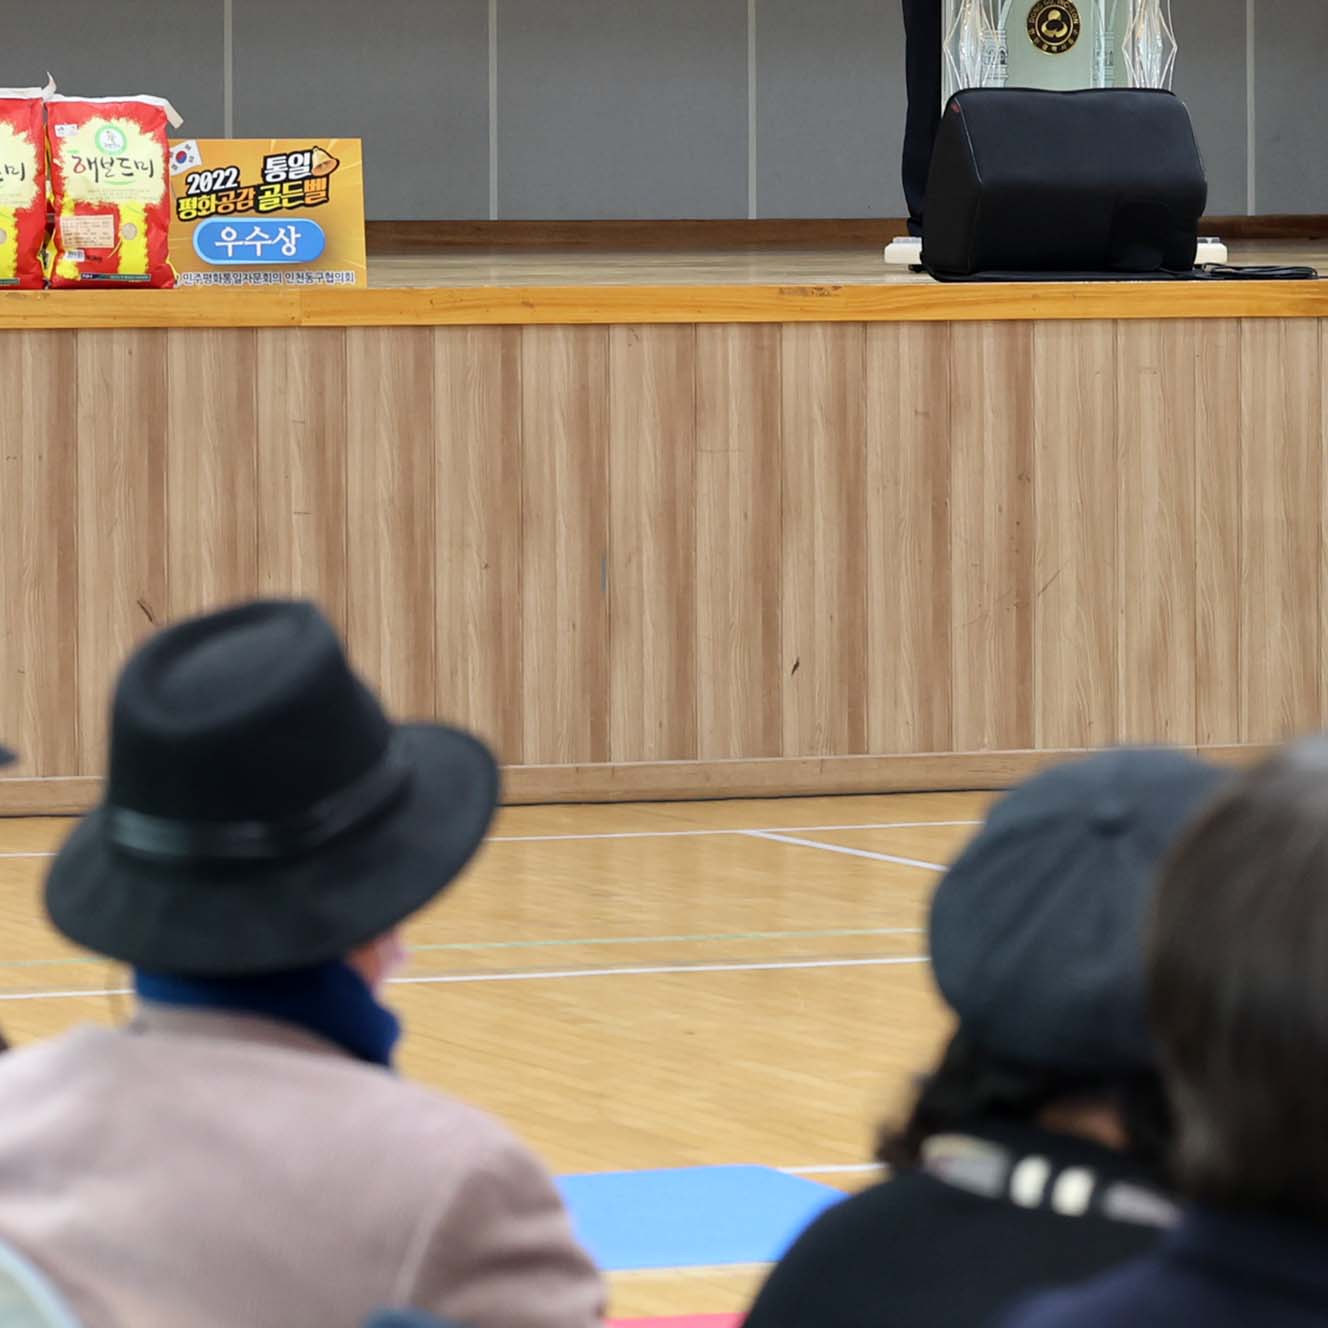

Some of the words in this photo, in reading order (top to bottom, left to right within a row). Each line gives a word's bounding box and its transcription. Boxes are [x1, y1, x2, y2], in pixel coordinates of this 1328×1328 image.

[187, 167, 239, 195] 2022
[264, 151, 312, 183] 통일
[178, 187, 257, 220] 평화공감
[257, 176, 328, 212] 골든벨
[214, 225, 302, 257] 우수상
